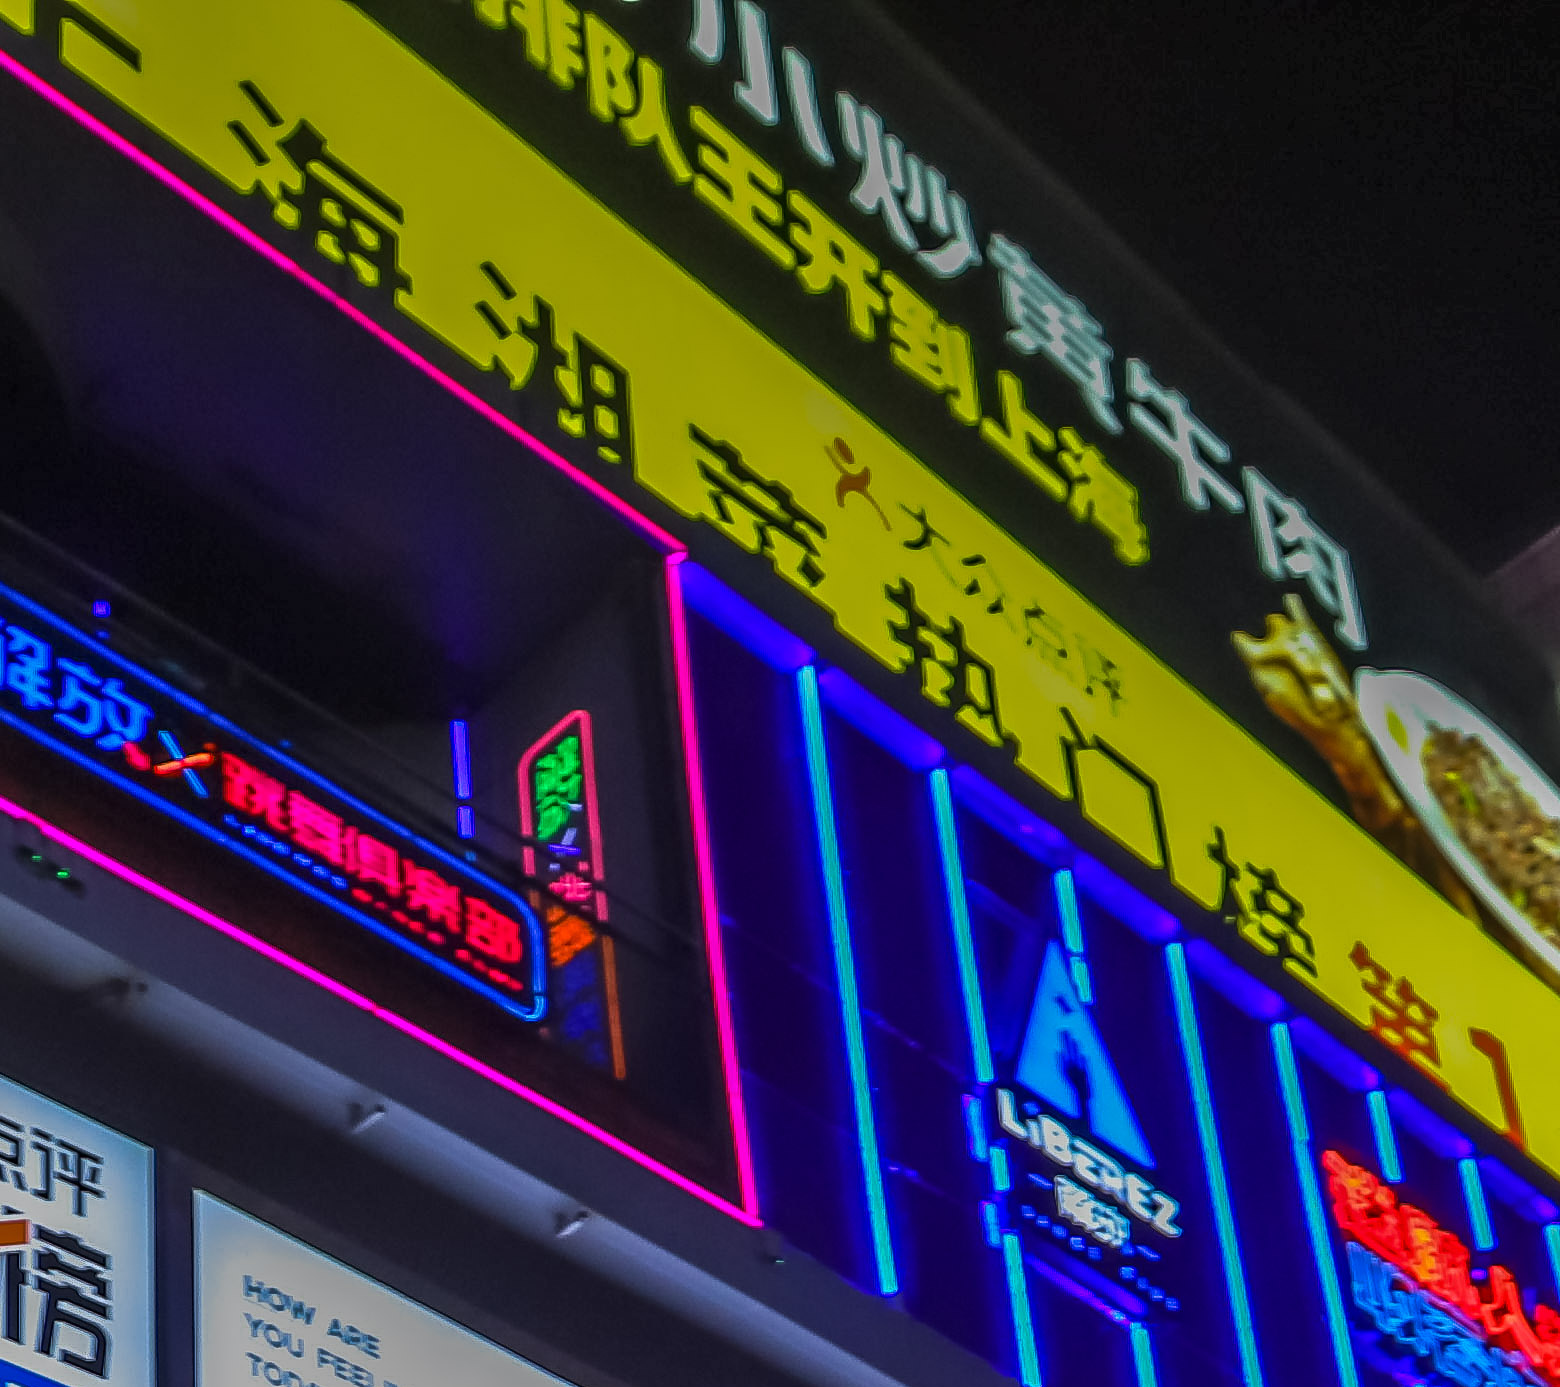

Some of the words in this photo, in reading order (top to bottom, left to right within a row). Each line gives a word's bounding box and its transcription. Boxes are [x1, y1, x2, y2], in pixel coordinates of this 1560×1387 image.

[242, 1274, 317, 1326] HOW
[327, 1318, 382, 1360] ARE
[244, 1312, 306, 1360] YOU
